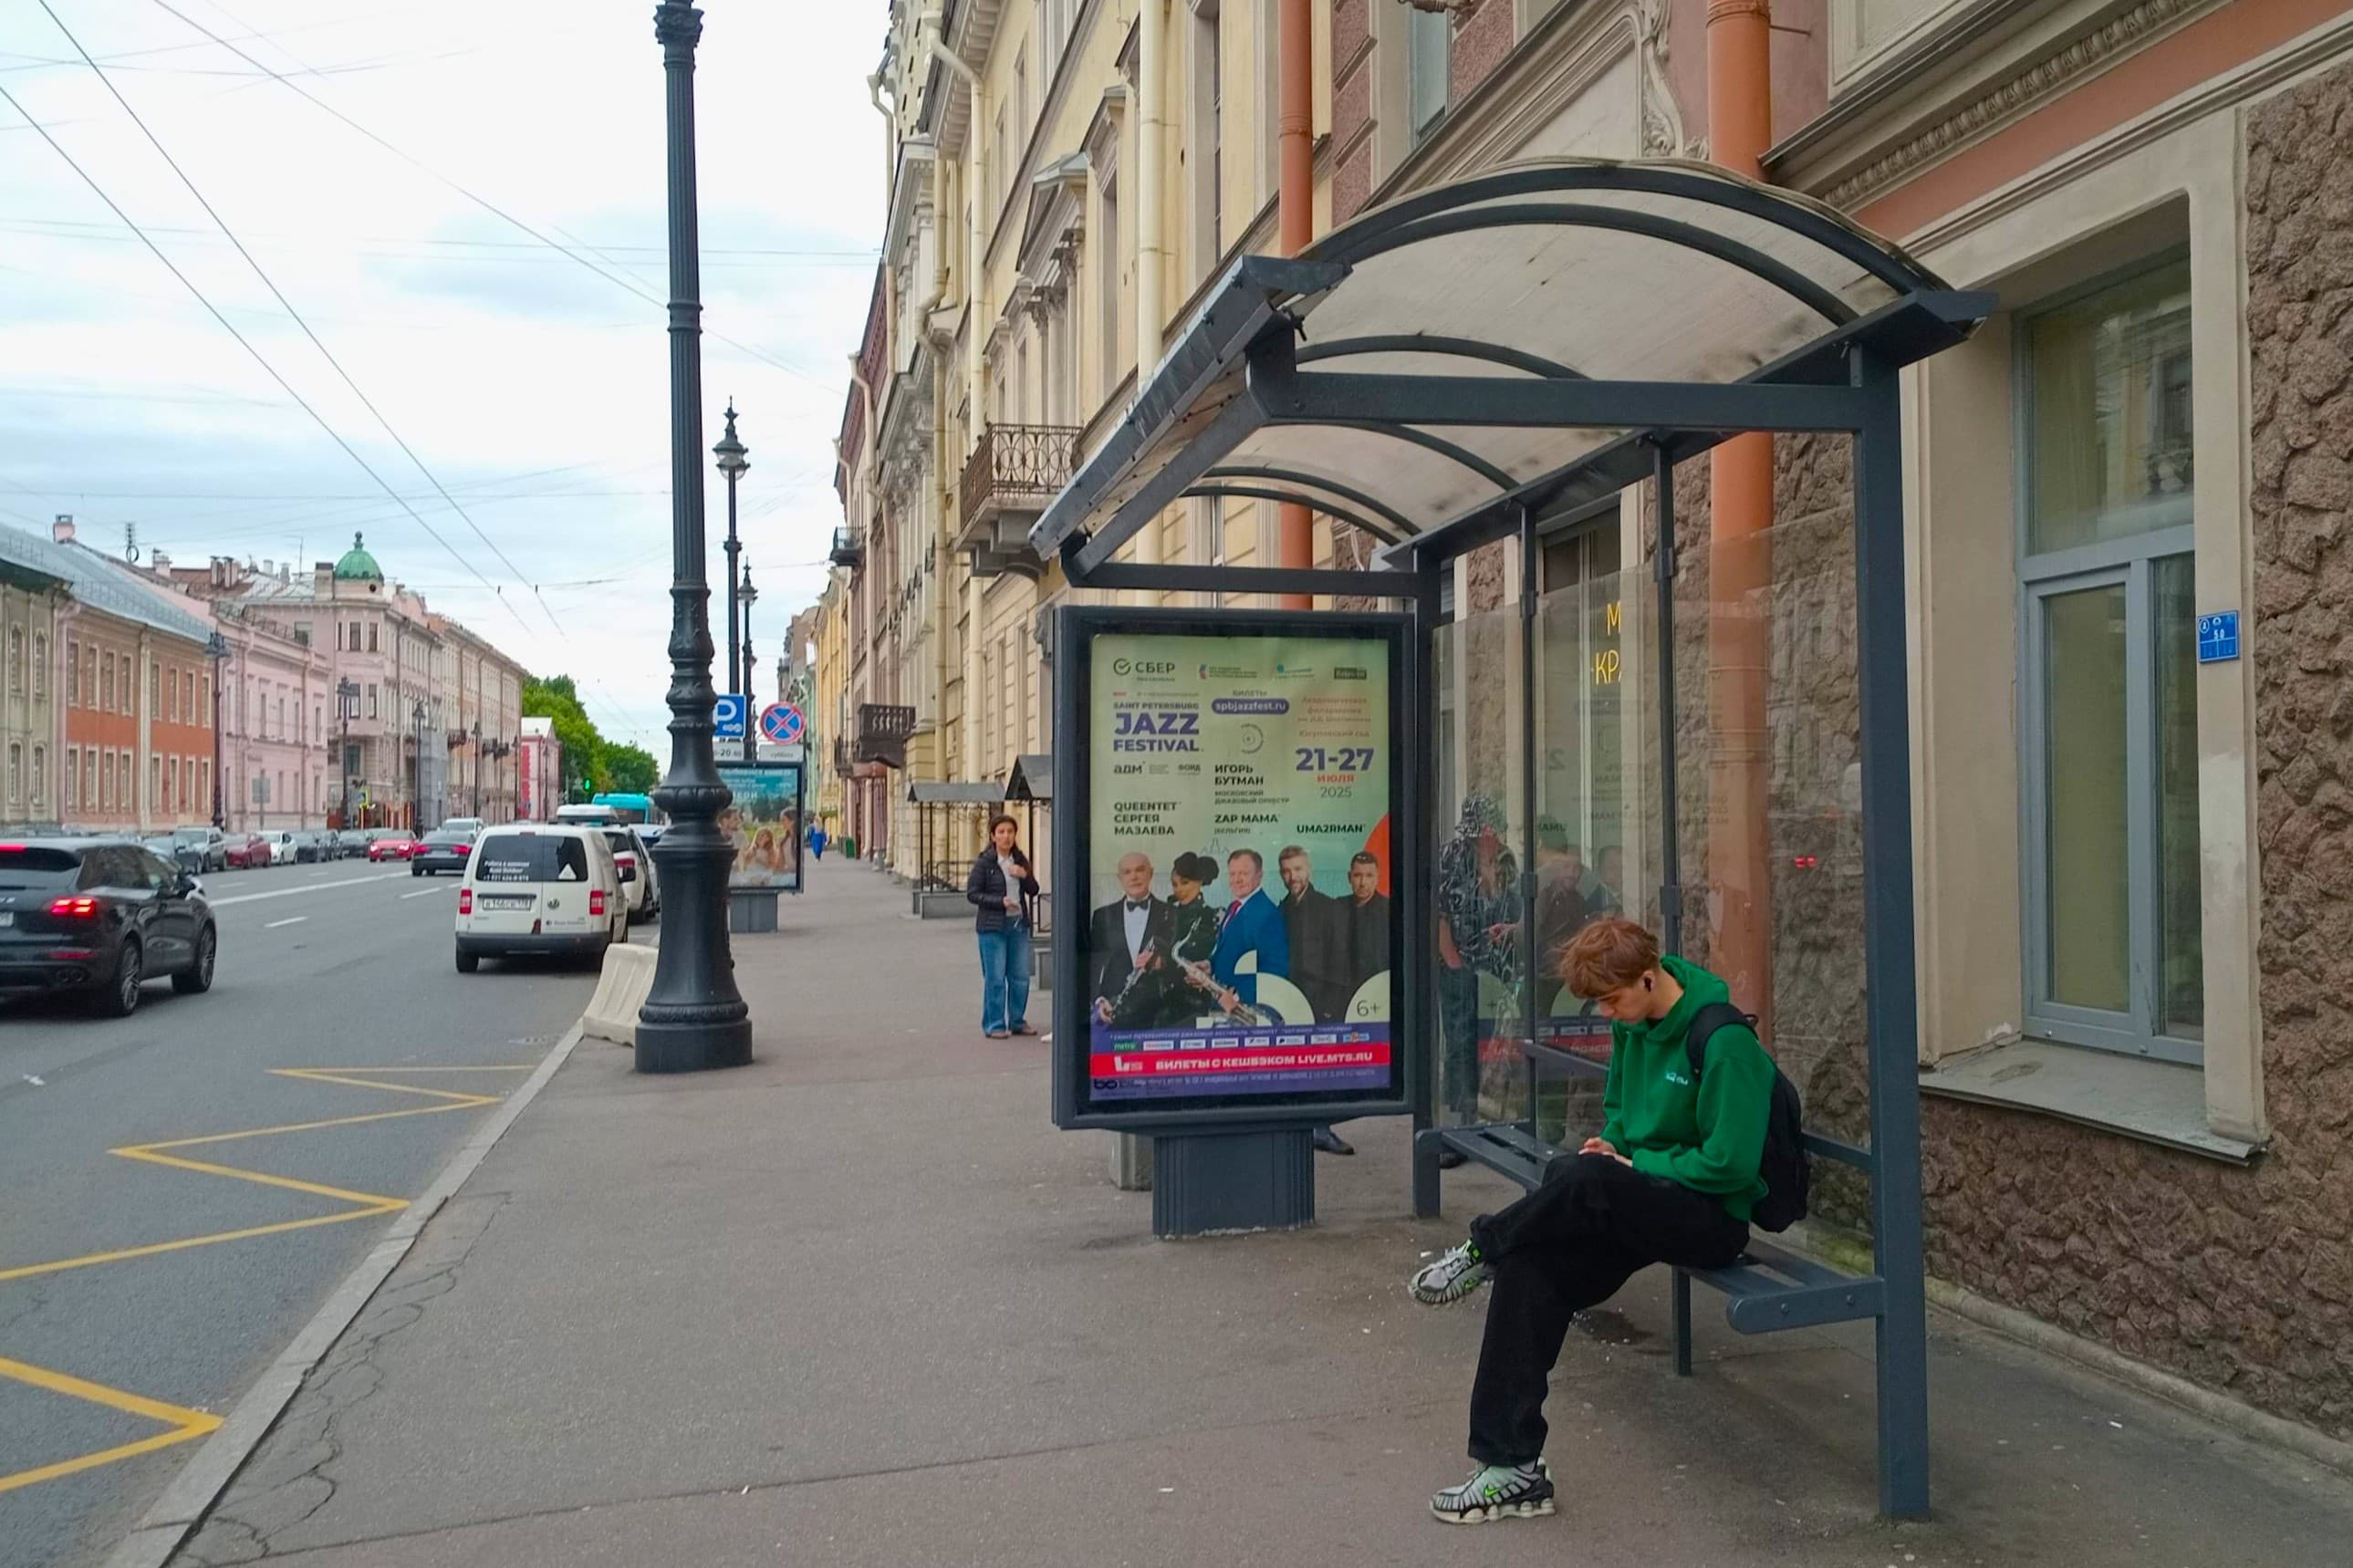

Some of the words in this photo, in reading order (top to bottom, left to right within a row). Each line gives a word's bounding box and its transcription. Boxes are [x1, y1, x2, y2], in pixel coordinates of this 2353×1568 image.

[1135, 661, 1176, 674] СБЕР
[1596, 649, 1622, 684] КР
[1113, 701, 1140, 710] SAINT
[1141, 701, 1200, 710] PETERSBURG
[1214, 701, 1287, 712] spbjazzfest.ru
[1114, 712, 1200, 735] JAZZ
[1296, 748, 1375, 771] 21-27
[1214, 764, 1254, 774] ИГОРЬ
[1214, 776, 1264, 785] БУТМАН
[1317, 774, 1355, 783] ИЮЛЯ
[1320, 786, 1352, 798] 2025
[1114, 814, 1160, 823] СЕРГЕЯ
[1214, 814, 1238, 824] ZAP
[1114, 826, 1175, 836] МАЗАЕВА
[1356, 999, 1381, 1018] 6+
[1155, 1058, 1210, 1071] БИЛЕТЫ
[1212, 1058, 1221, 1068] С
[1223, 1055, 1296, 1068] КЕШБЭКОМ
[1297, 1052, 1374, 1064] LIVE.MTS.RU
